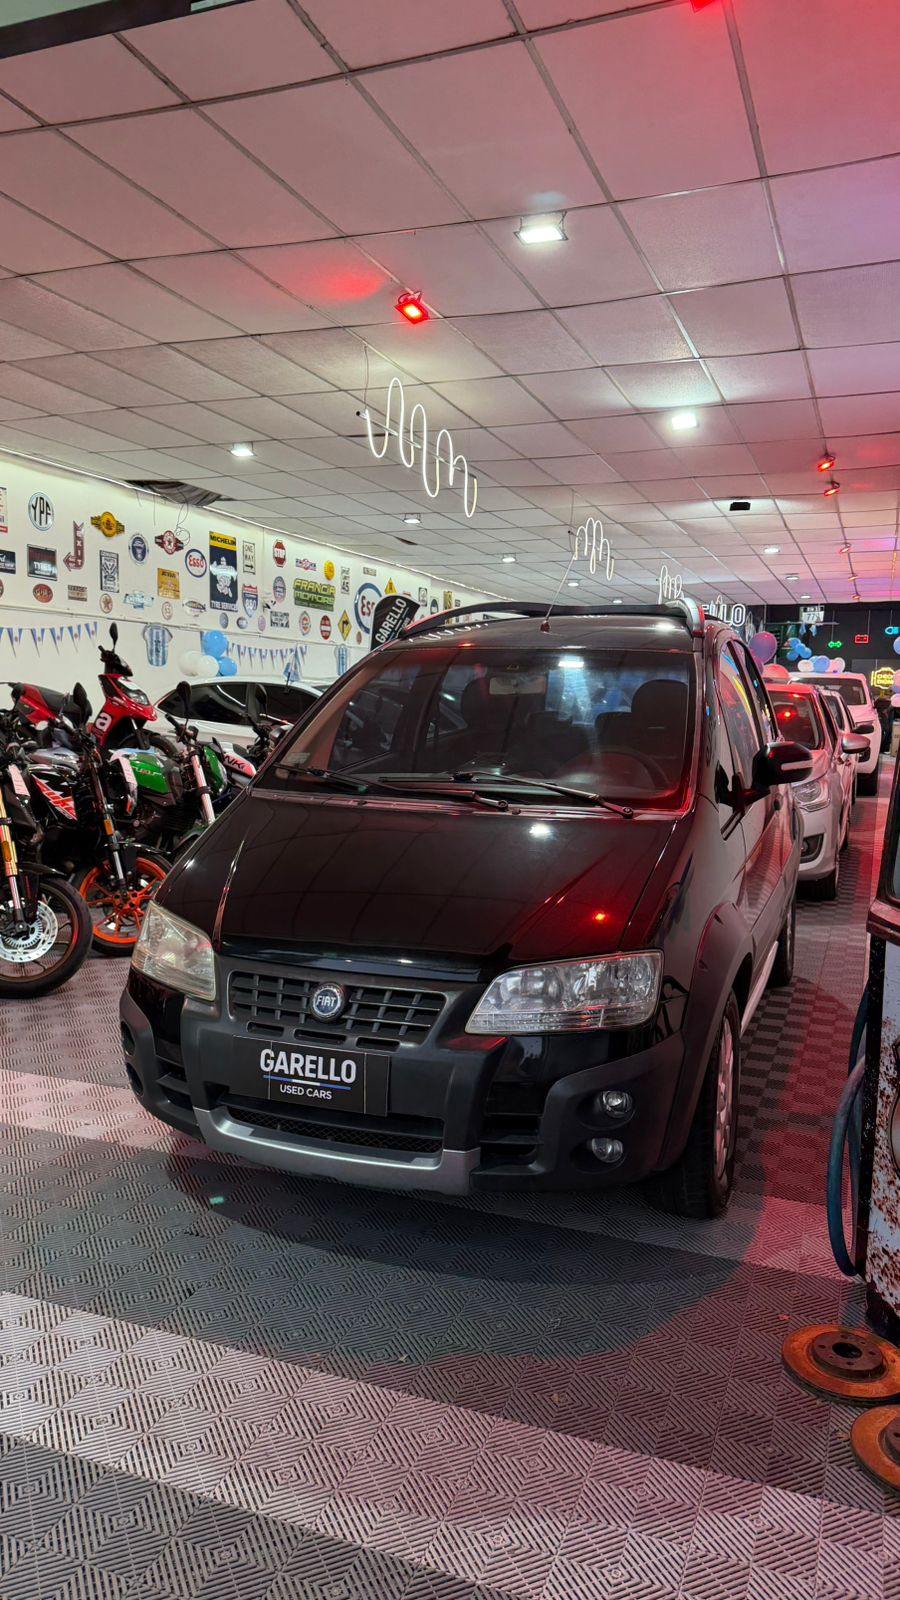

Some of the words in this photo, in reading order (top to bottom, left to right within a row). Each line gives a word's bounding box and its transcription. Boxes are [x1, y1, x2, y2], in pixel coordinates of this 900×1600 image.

[31, 496, 51, 526] YPF
[210, 534, 237, 545] MICHELIN
[244, 544, 253, 553] ONE
[244, 552, 254, 561] WAY
[375, 598, 407, 643] GARELLO
[316, 995, 337, 1008] FIAT
[259, 1048, 357, 1084] GARELLO
[279, 1084, 304, 1097] USED
[306, 1087, 332, 1100] CARS
